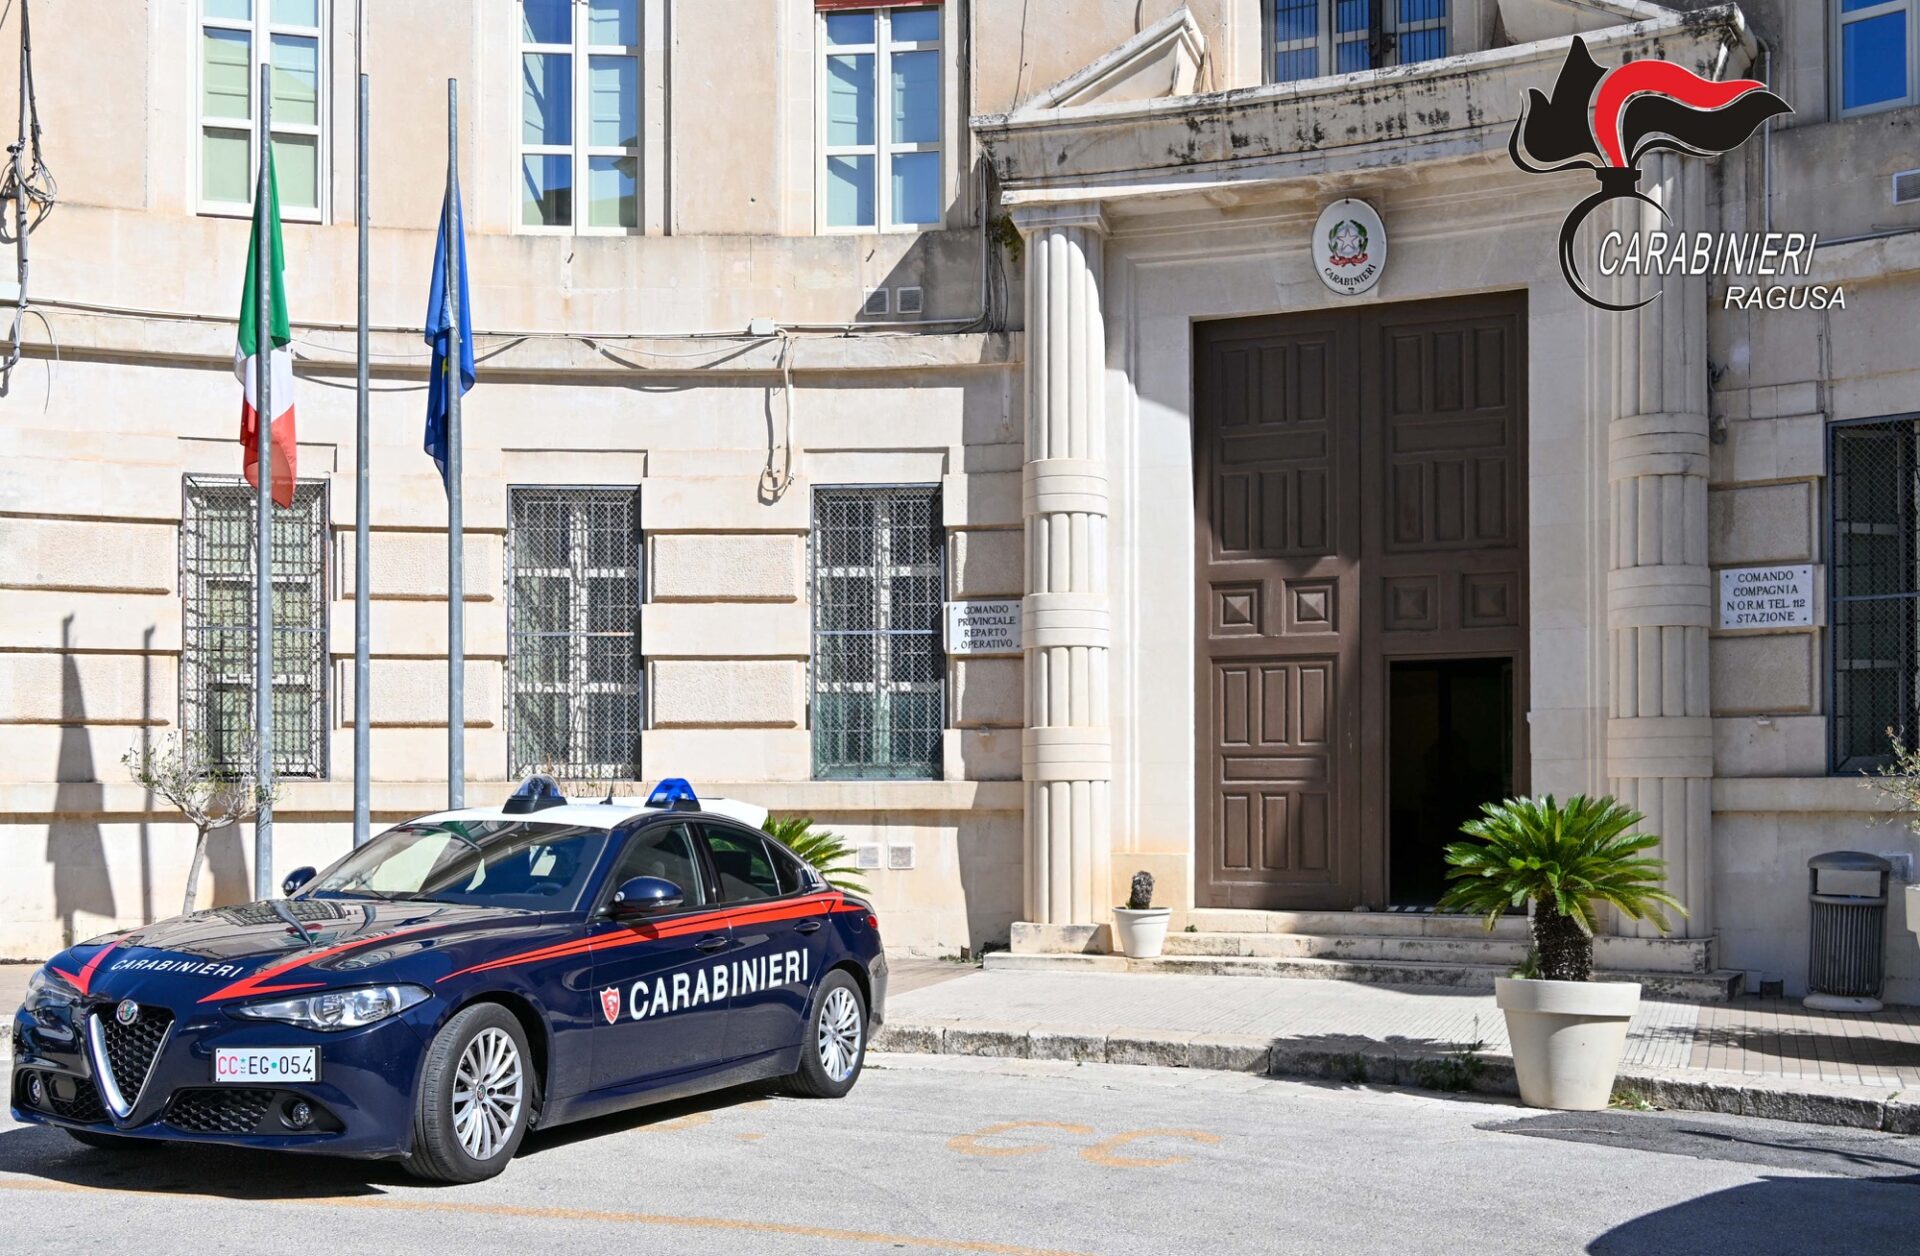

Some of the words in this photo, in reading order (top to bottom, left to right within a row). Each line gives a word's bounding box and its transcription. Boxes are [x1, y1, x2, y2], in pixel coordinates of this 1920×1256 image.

[1324, 263, 1377, 286] CARABINIERI
[1737, 570, 1794, 583] COMANDO
[1733, 584, 1799, 597] COMPAGNIA
[1792, 598, 1806, 608] 112
[964, 605, 1009, 615] COMANDO
[958, 616, 1016, 627] PROVINCIALE
[1736, 611, 1795, 624] STAZIONE
[964, 628, 1008, 638] REPARTO
[961, 639, 1013, 650] OPERATIVO
[111, 959, 244, 978] CARABINIERI
[629, 948, 808, 1020] CARABINIERI
[279, 1055, 313, 1075] 054
